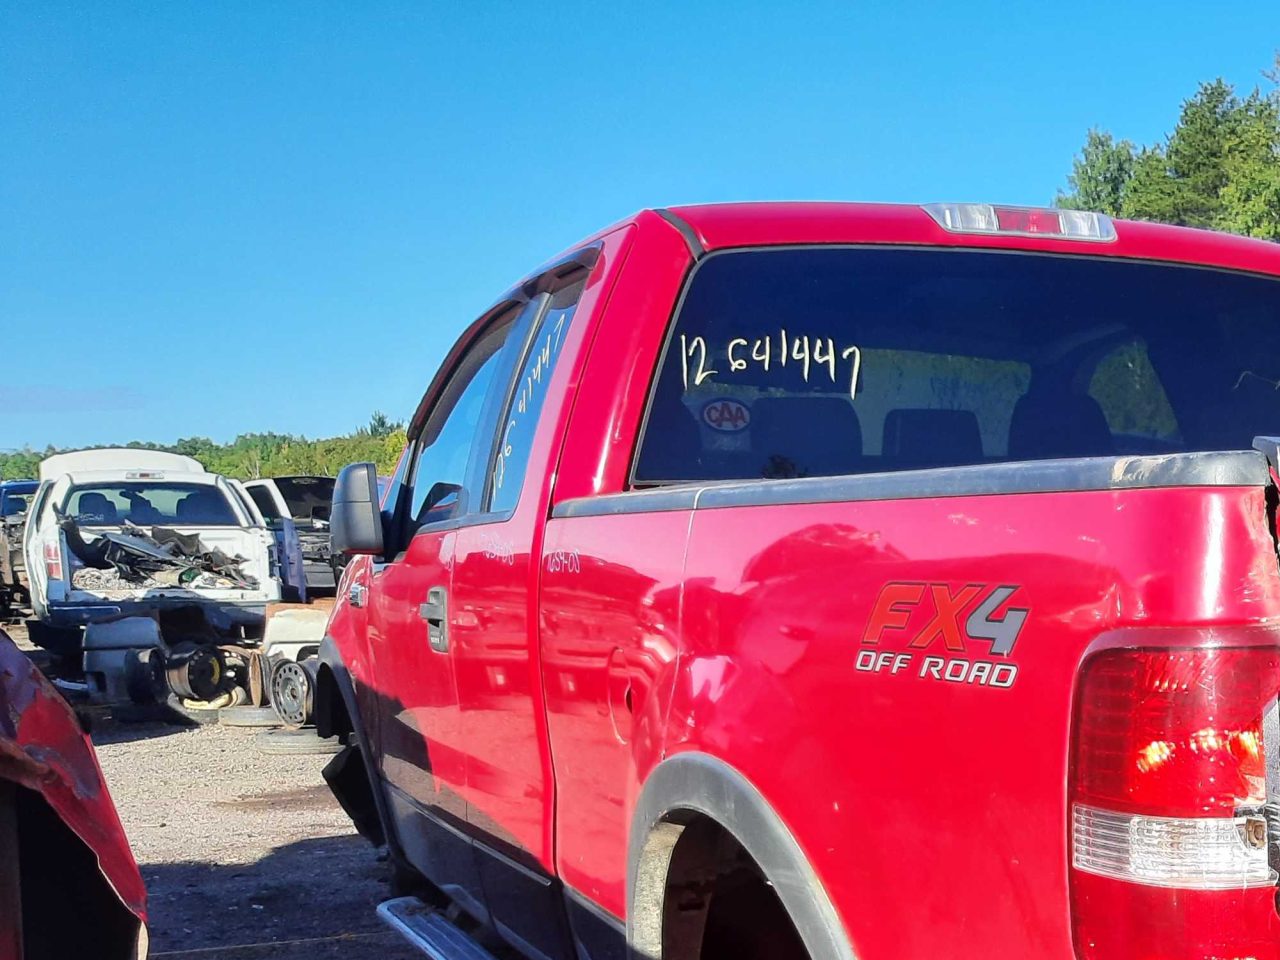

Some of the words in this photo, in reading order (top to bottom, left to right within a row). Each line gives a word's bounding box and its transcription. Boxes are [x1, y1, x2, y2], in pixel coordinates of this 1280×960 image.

[680, 333, 718, 391] 12
[728, 328, 861, 401] 641447
[705, 399, 747, 429] CAA
[861, 580, 1032, 656] FX4
[855, 649, 912, 676] OFF
[918, 655, 1019, 689] ROAD
